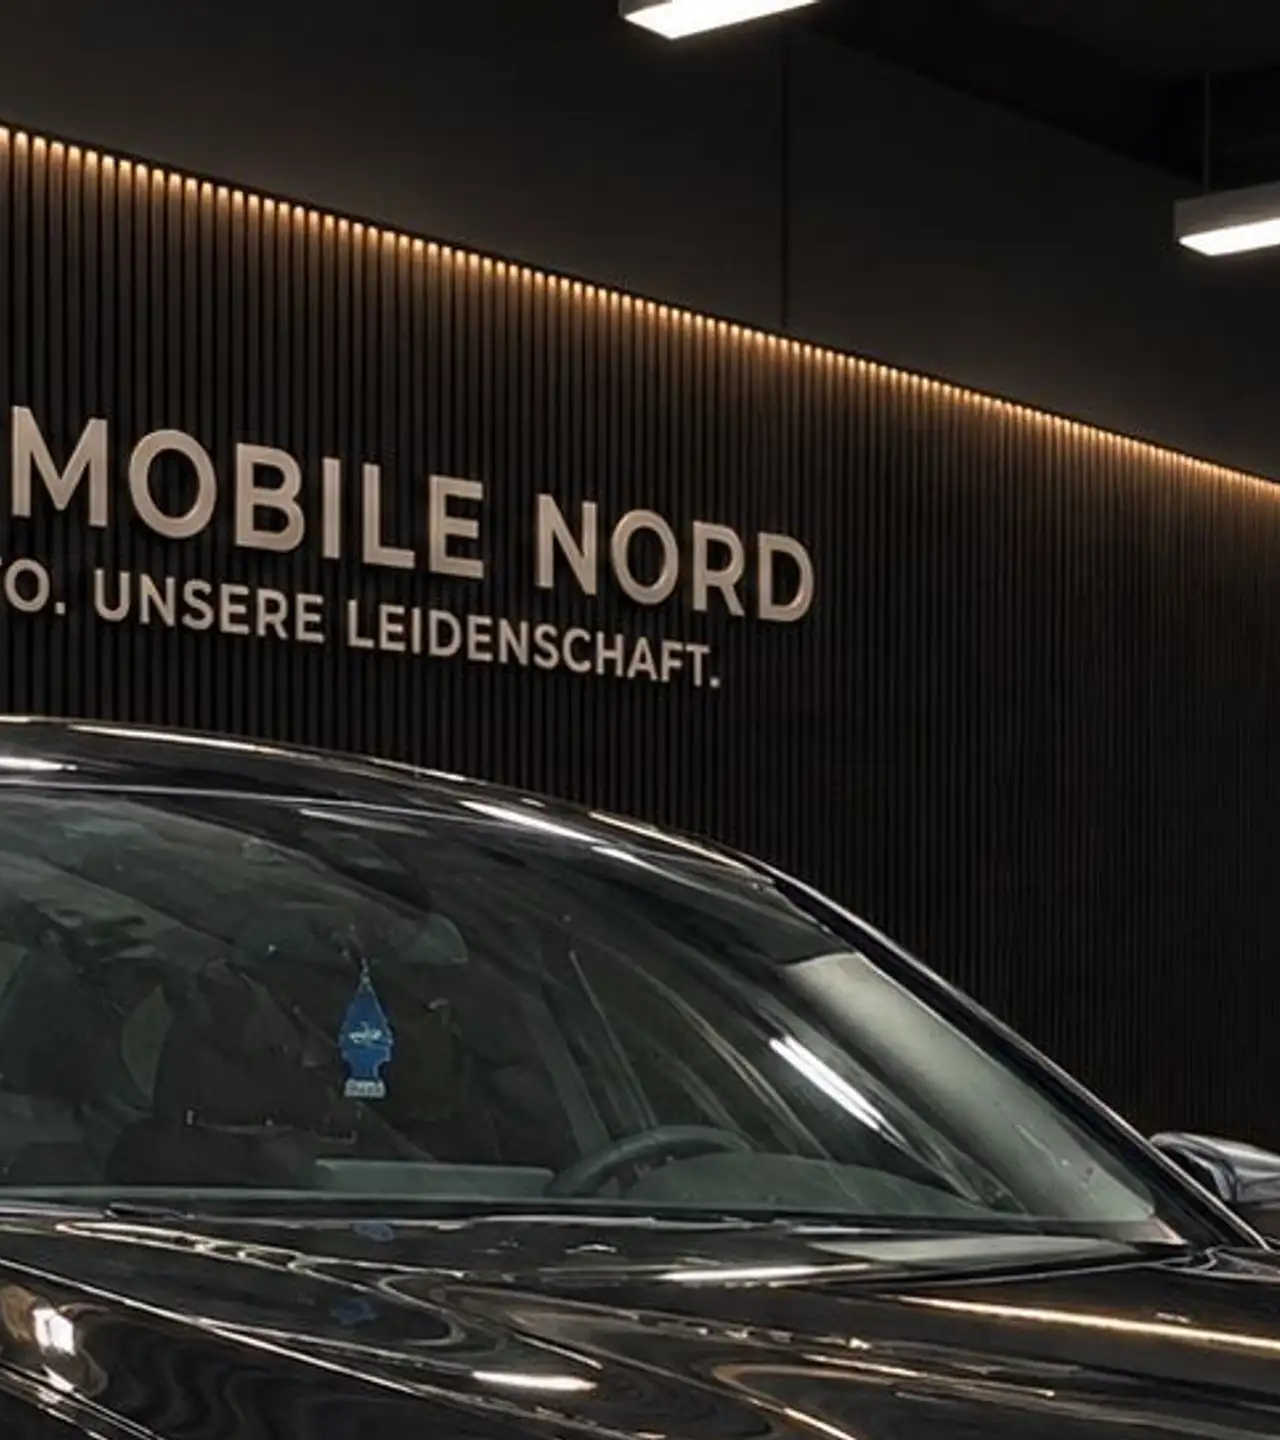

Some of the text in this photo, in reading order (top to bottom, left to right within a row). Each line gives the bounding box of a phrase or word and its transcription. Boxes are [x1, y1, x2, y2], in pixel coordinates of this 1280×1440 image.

[536, 493, 815, 623] NORD
[94, 567, 325, 643] UNSERE
[347, 598, 720, 688] LEIDENSCHAFT.
